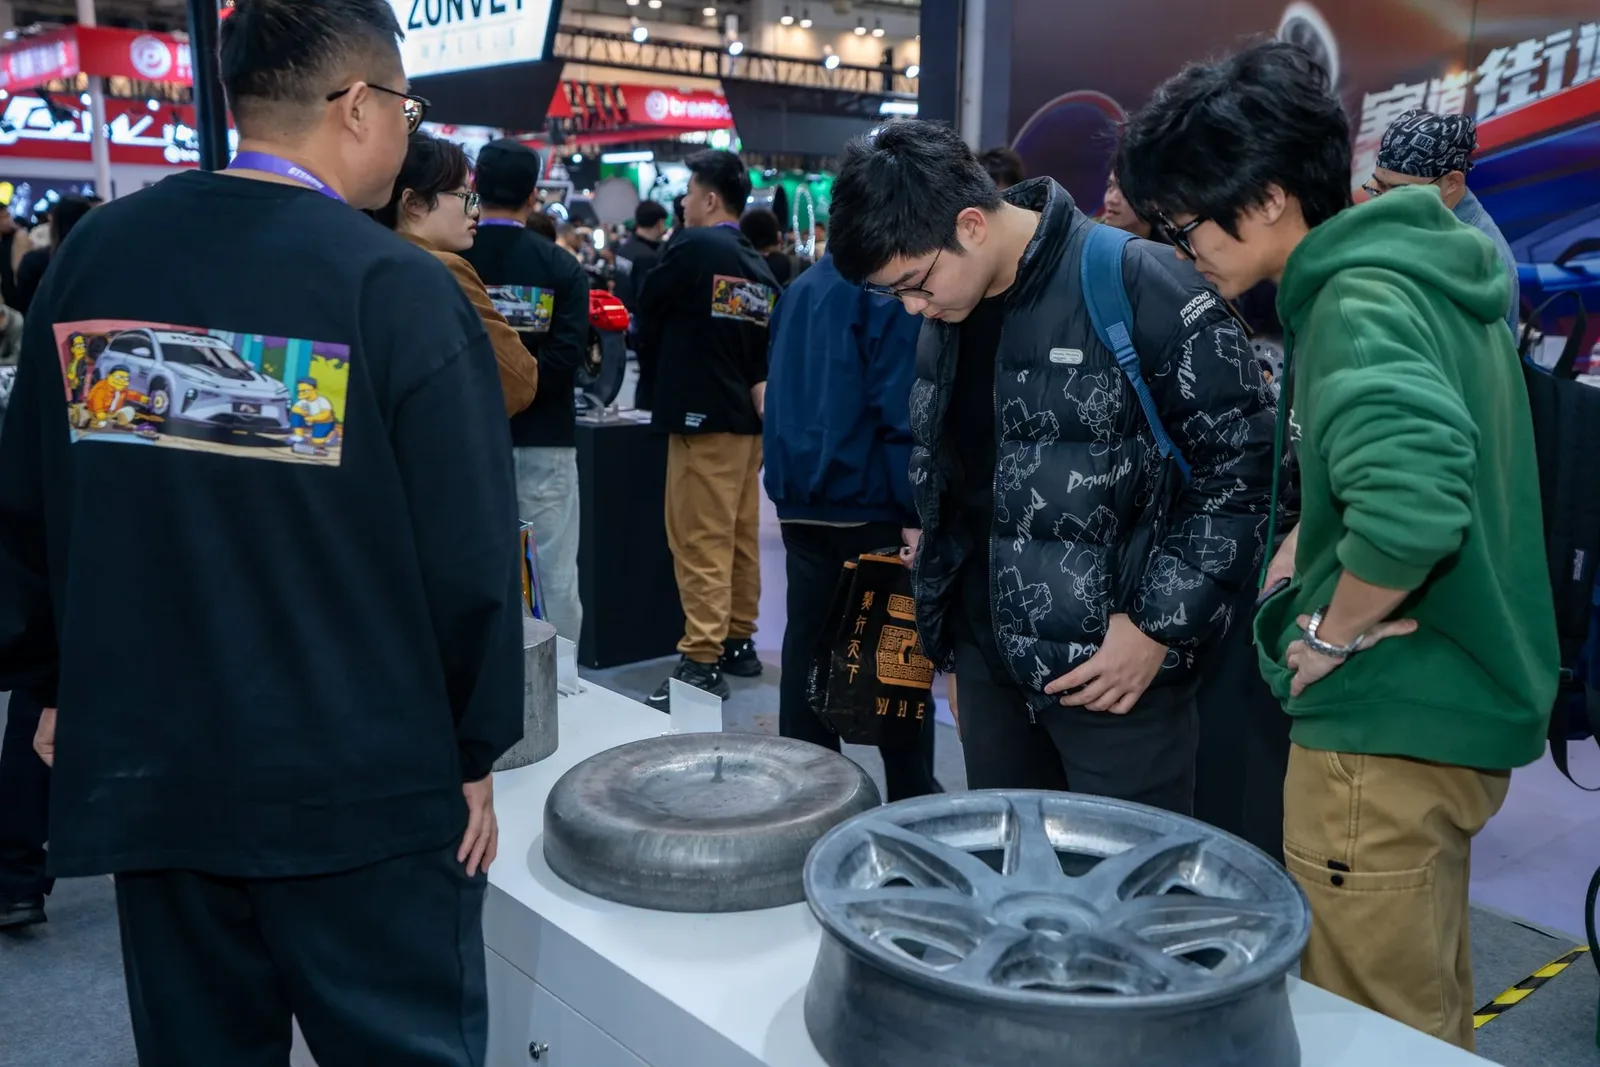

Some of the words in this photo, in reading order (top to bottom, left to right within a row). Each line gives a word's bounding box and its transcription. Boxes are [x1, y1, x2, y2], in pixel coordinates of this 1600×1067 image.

[408, 0, 522, 30] ZONV
[1180, 290, 1211, 318] PSYCHO
[1183, 298, 1216, 327] MONKEY
